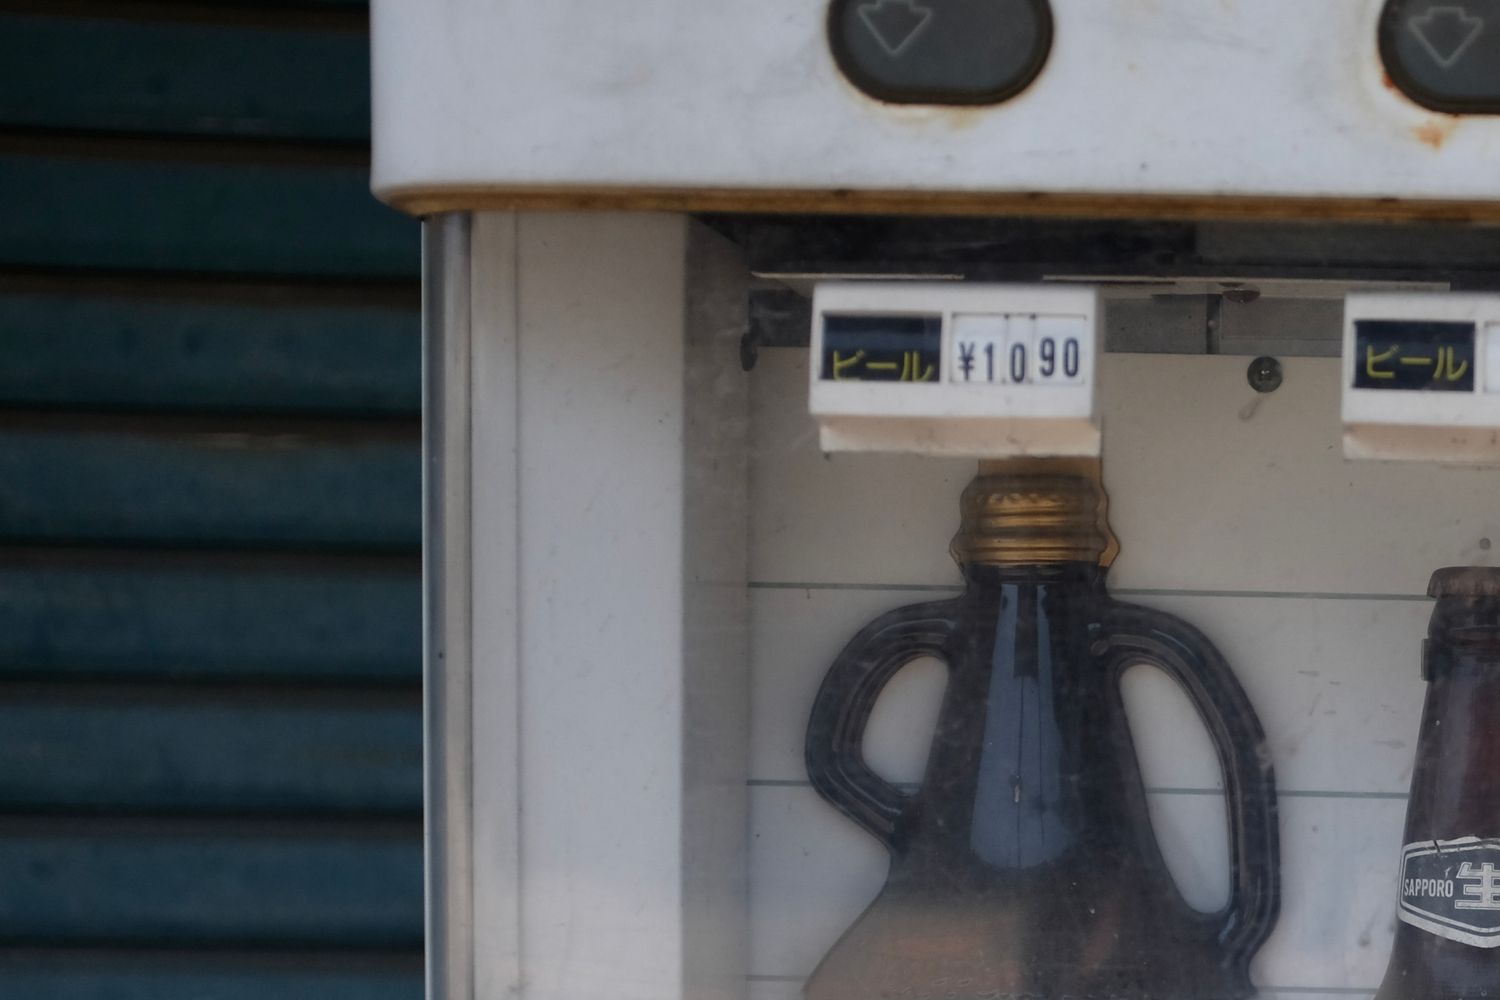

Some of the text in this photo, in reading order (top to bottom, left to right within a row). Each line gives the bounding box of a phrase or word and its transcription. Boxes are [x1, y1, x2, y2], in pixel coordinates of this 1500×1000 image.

[833, 337, 1079, 383] ビール ¥1090
[1365, 344, 1468, 381] ビール
[1403, 877, 1455, 898] SAPPORO
